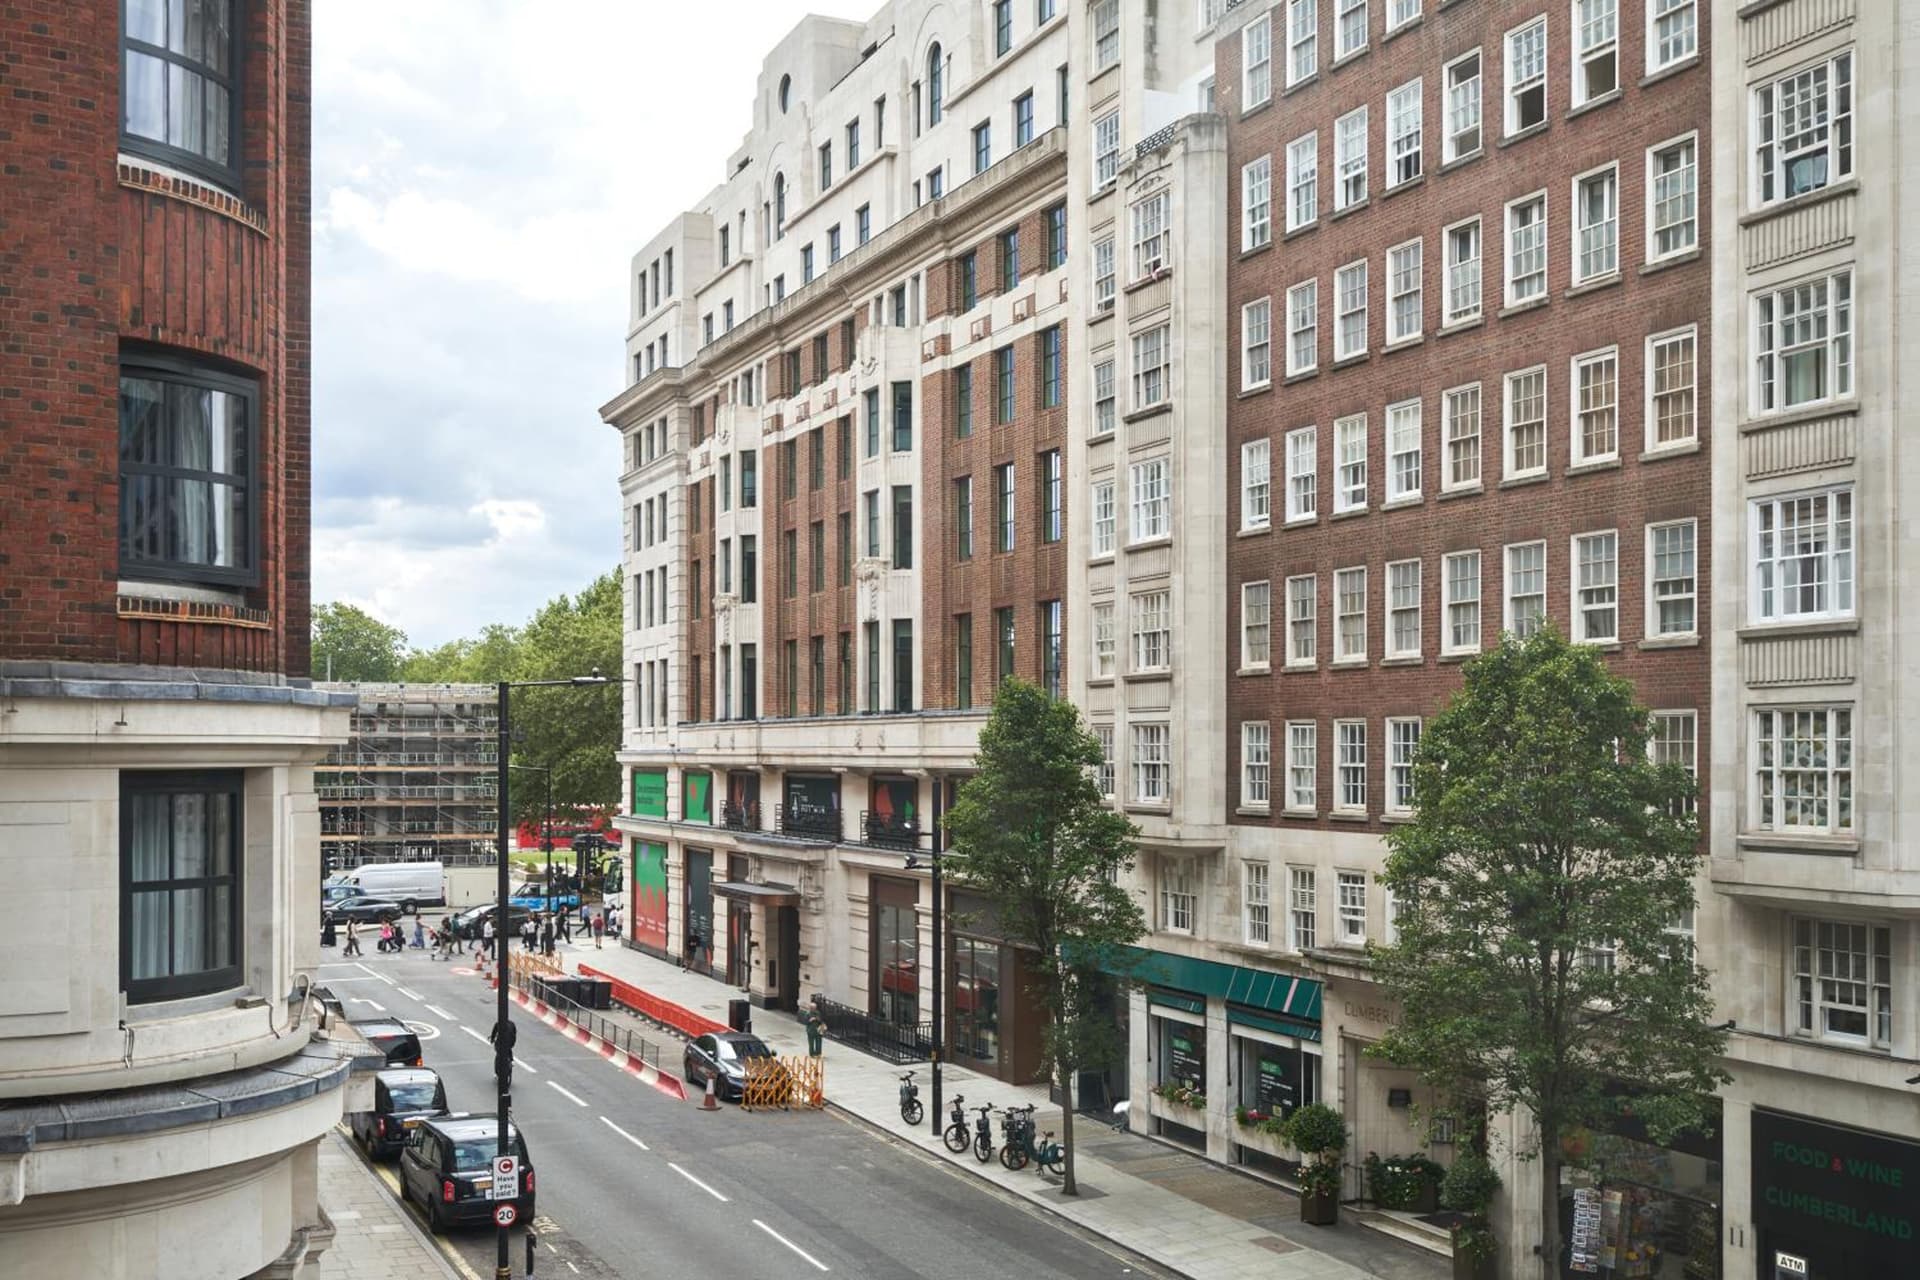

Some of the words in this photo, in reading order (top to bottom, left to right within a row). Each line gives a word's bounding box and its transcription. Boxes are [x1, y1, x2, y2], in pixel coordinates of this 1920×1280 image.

[1773, 1142, 1829, 1168] FOOD
[1832, 1155, 1842, 1172] &
[1847, 1158, 1904, 1189] WINE
[499, 1210, 513, 1220] 20
[1766, 1186, 1912, 1239] CUMBERLAND
[1780, 1256, 1803, 1271] ATM
